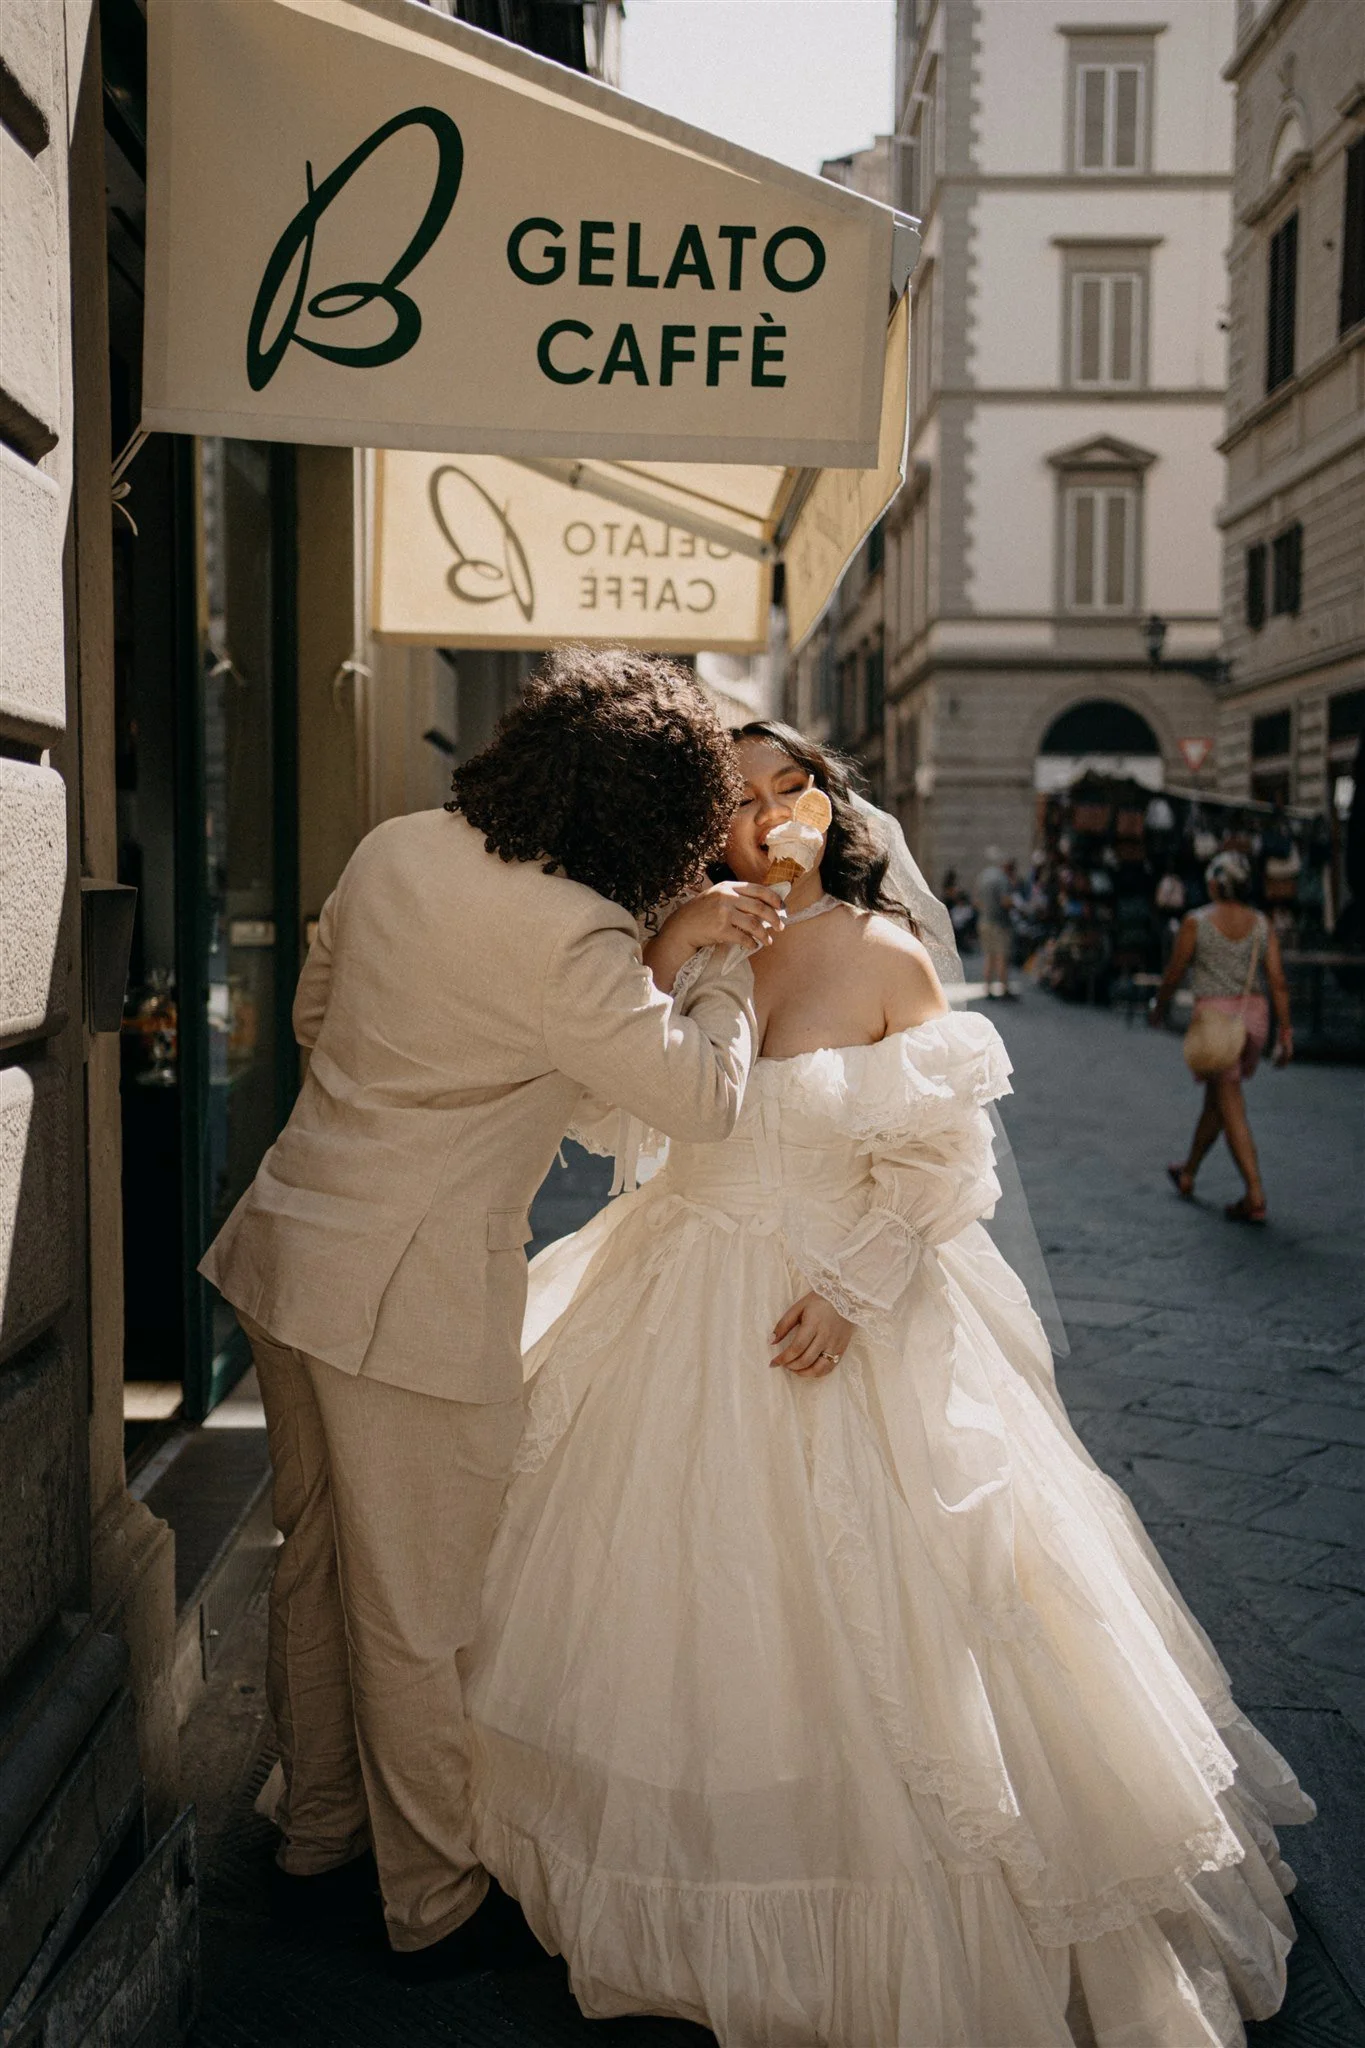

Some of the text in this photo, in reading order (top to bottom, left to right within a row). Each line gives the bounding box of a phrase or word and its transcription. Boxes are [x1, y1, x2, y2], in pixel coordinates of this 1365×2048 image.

[247, 106, 464, 392] B
[506, 217, 826, 293] GELATO
[536, 312, 787, 388] CAFFÈ
